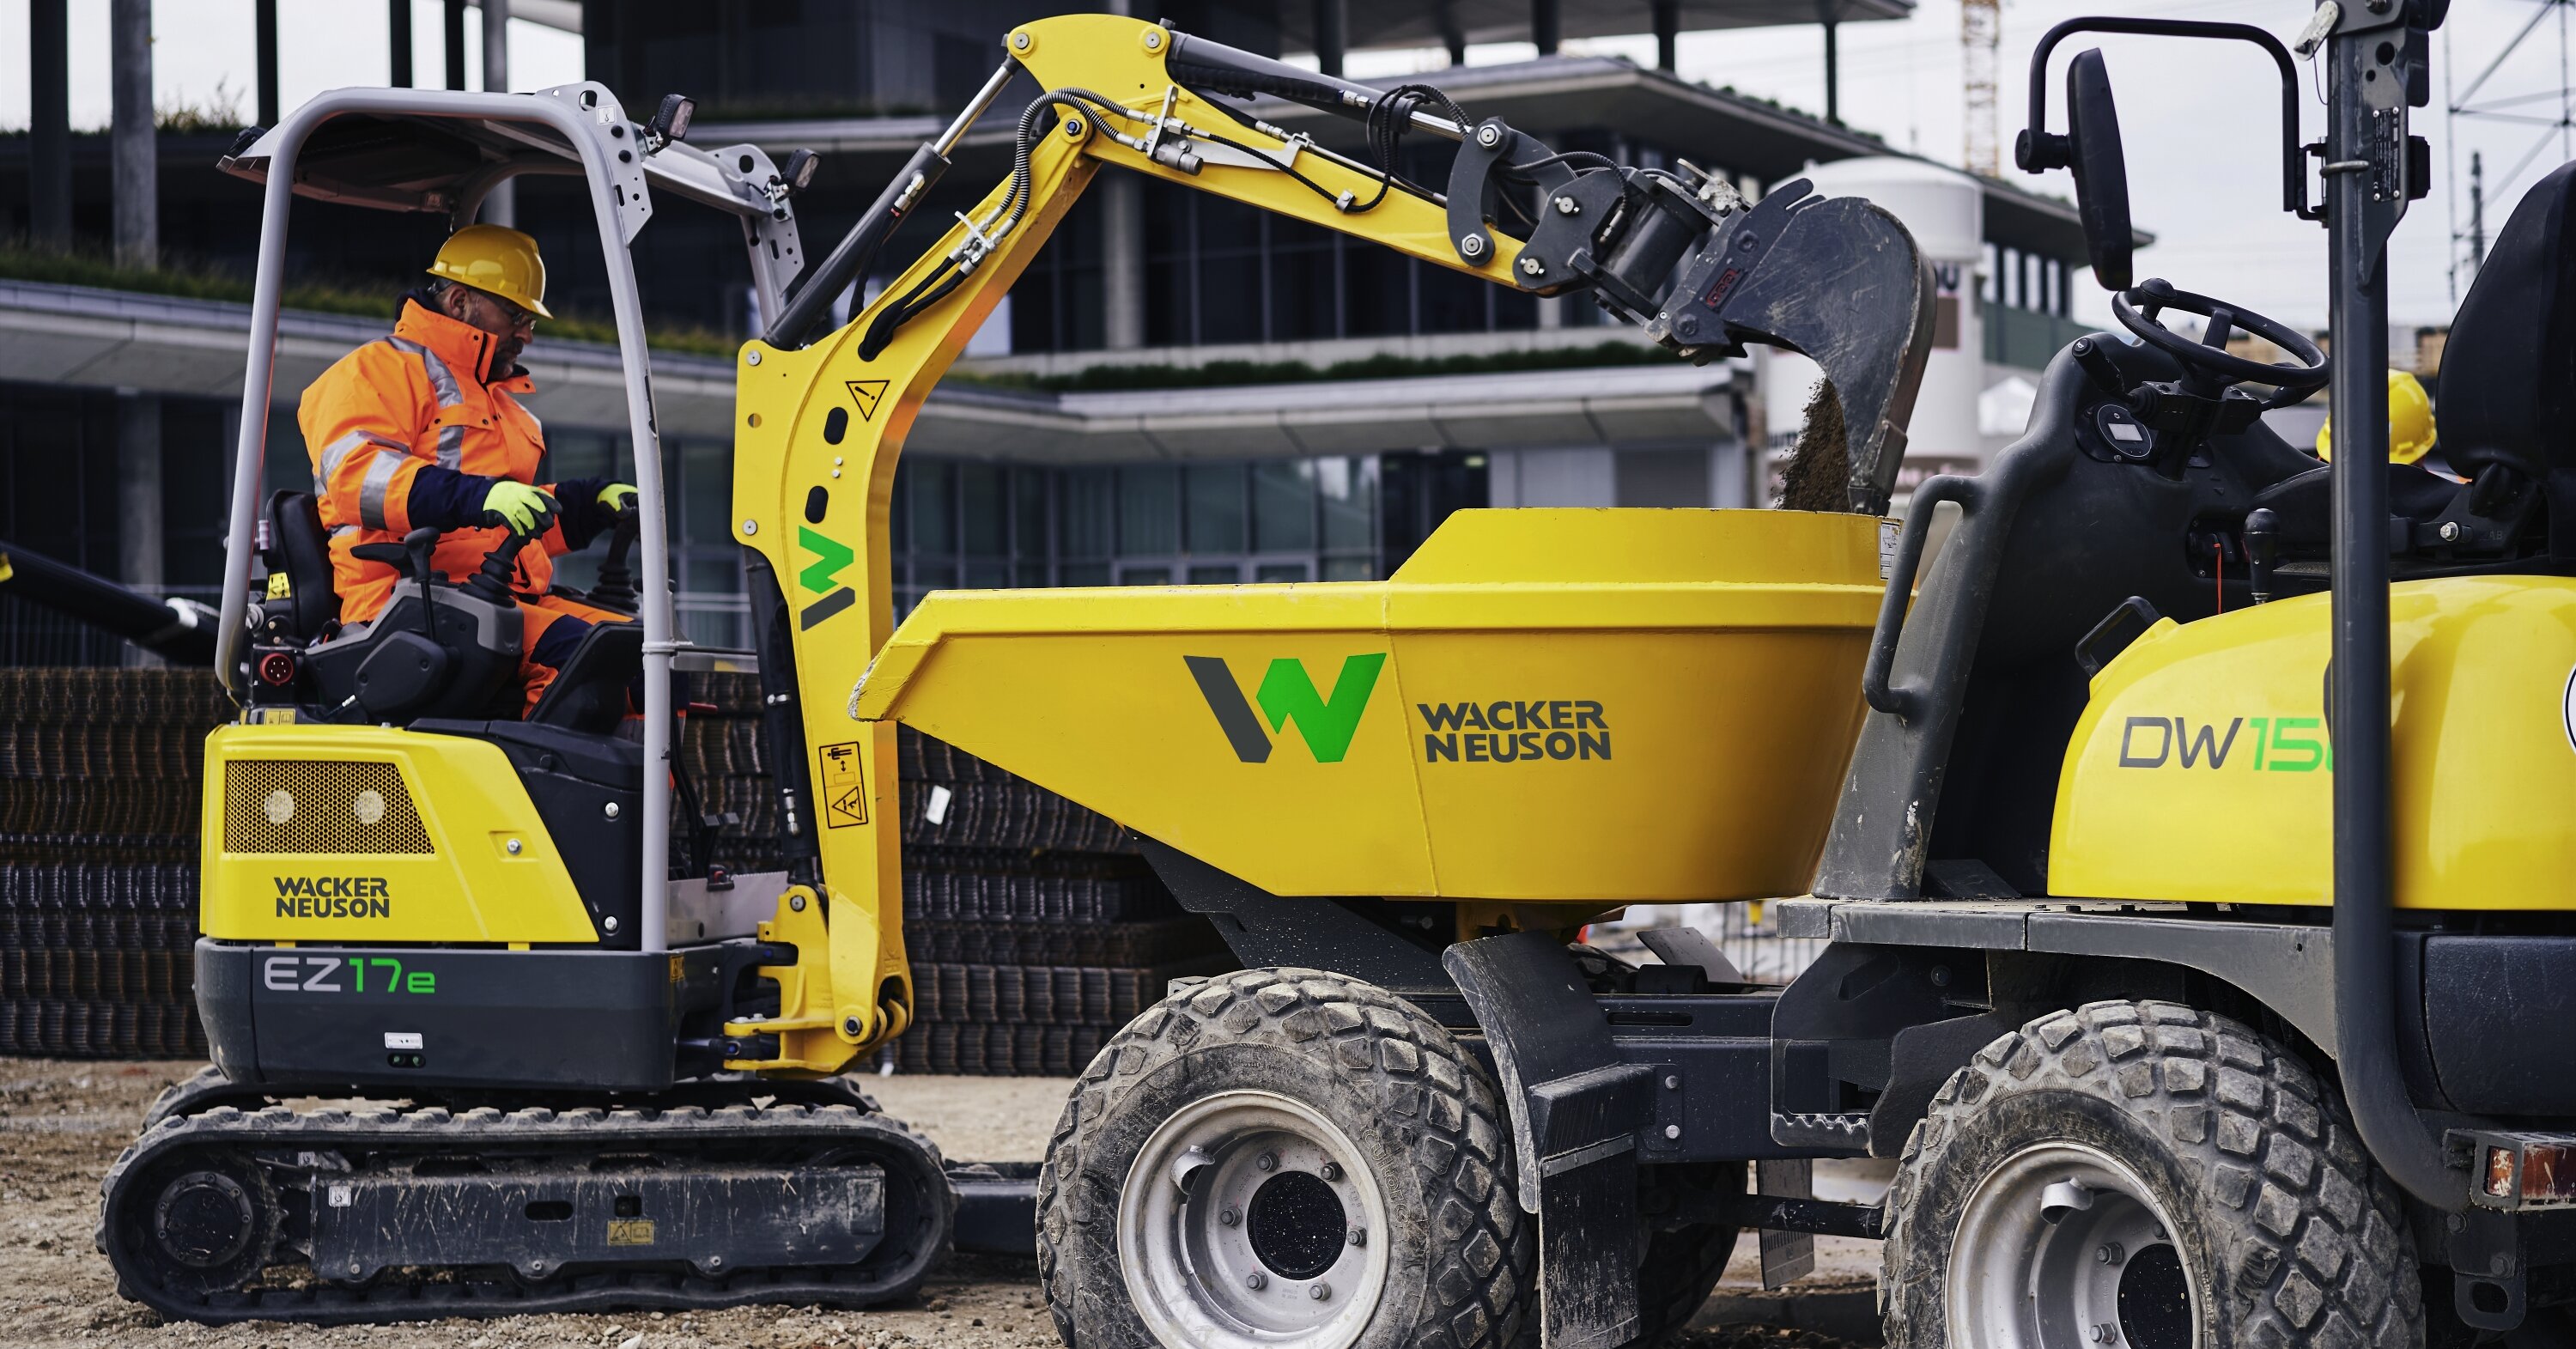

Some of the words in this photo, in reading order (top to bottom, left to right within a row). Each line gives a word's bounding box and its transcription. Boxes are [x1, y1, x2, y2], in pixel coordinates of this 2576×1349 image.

[1417, 700, 1608, 731] WACKER
[1425, 731, 1612, 763] NEUSON
[2118, 716, 2333, 773] DW15
[274, 877, 388, 897] WACKER
[276, 897, 390, 918] NEUSON
[264, 957, 435, 994] EZ17e
